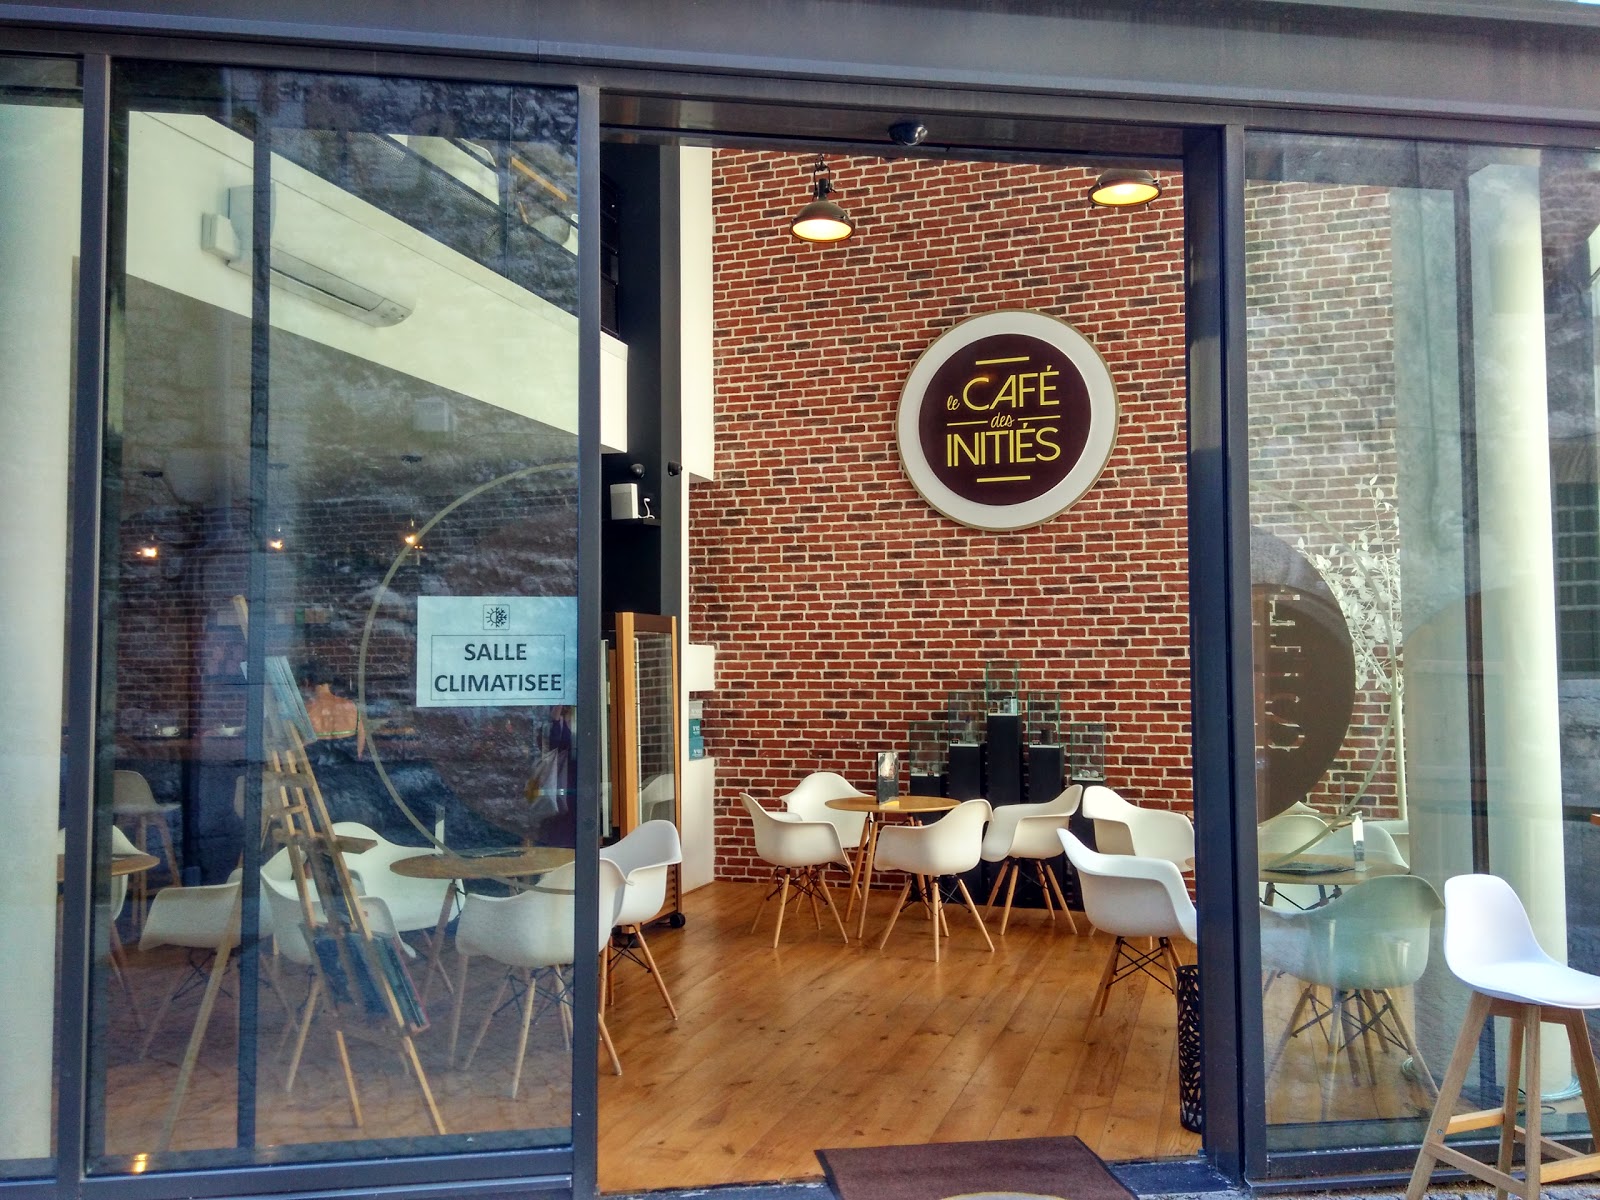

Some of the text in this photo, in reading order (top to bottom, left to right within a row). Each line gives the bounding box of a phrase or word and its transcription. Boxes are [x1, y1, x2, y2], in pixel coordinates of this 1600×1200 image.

[947, 365, 1060, 411] le CAFÉ
[990, 411, 1015, 428] des
[946, 422, 1061, 467] INITIÉS
[464, 643, 527, 661] SALLE
[434, 673, 562, 693] CLIMATISEE
